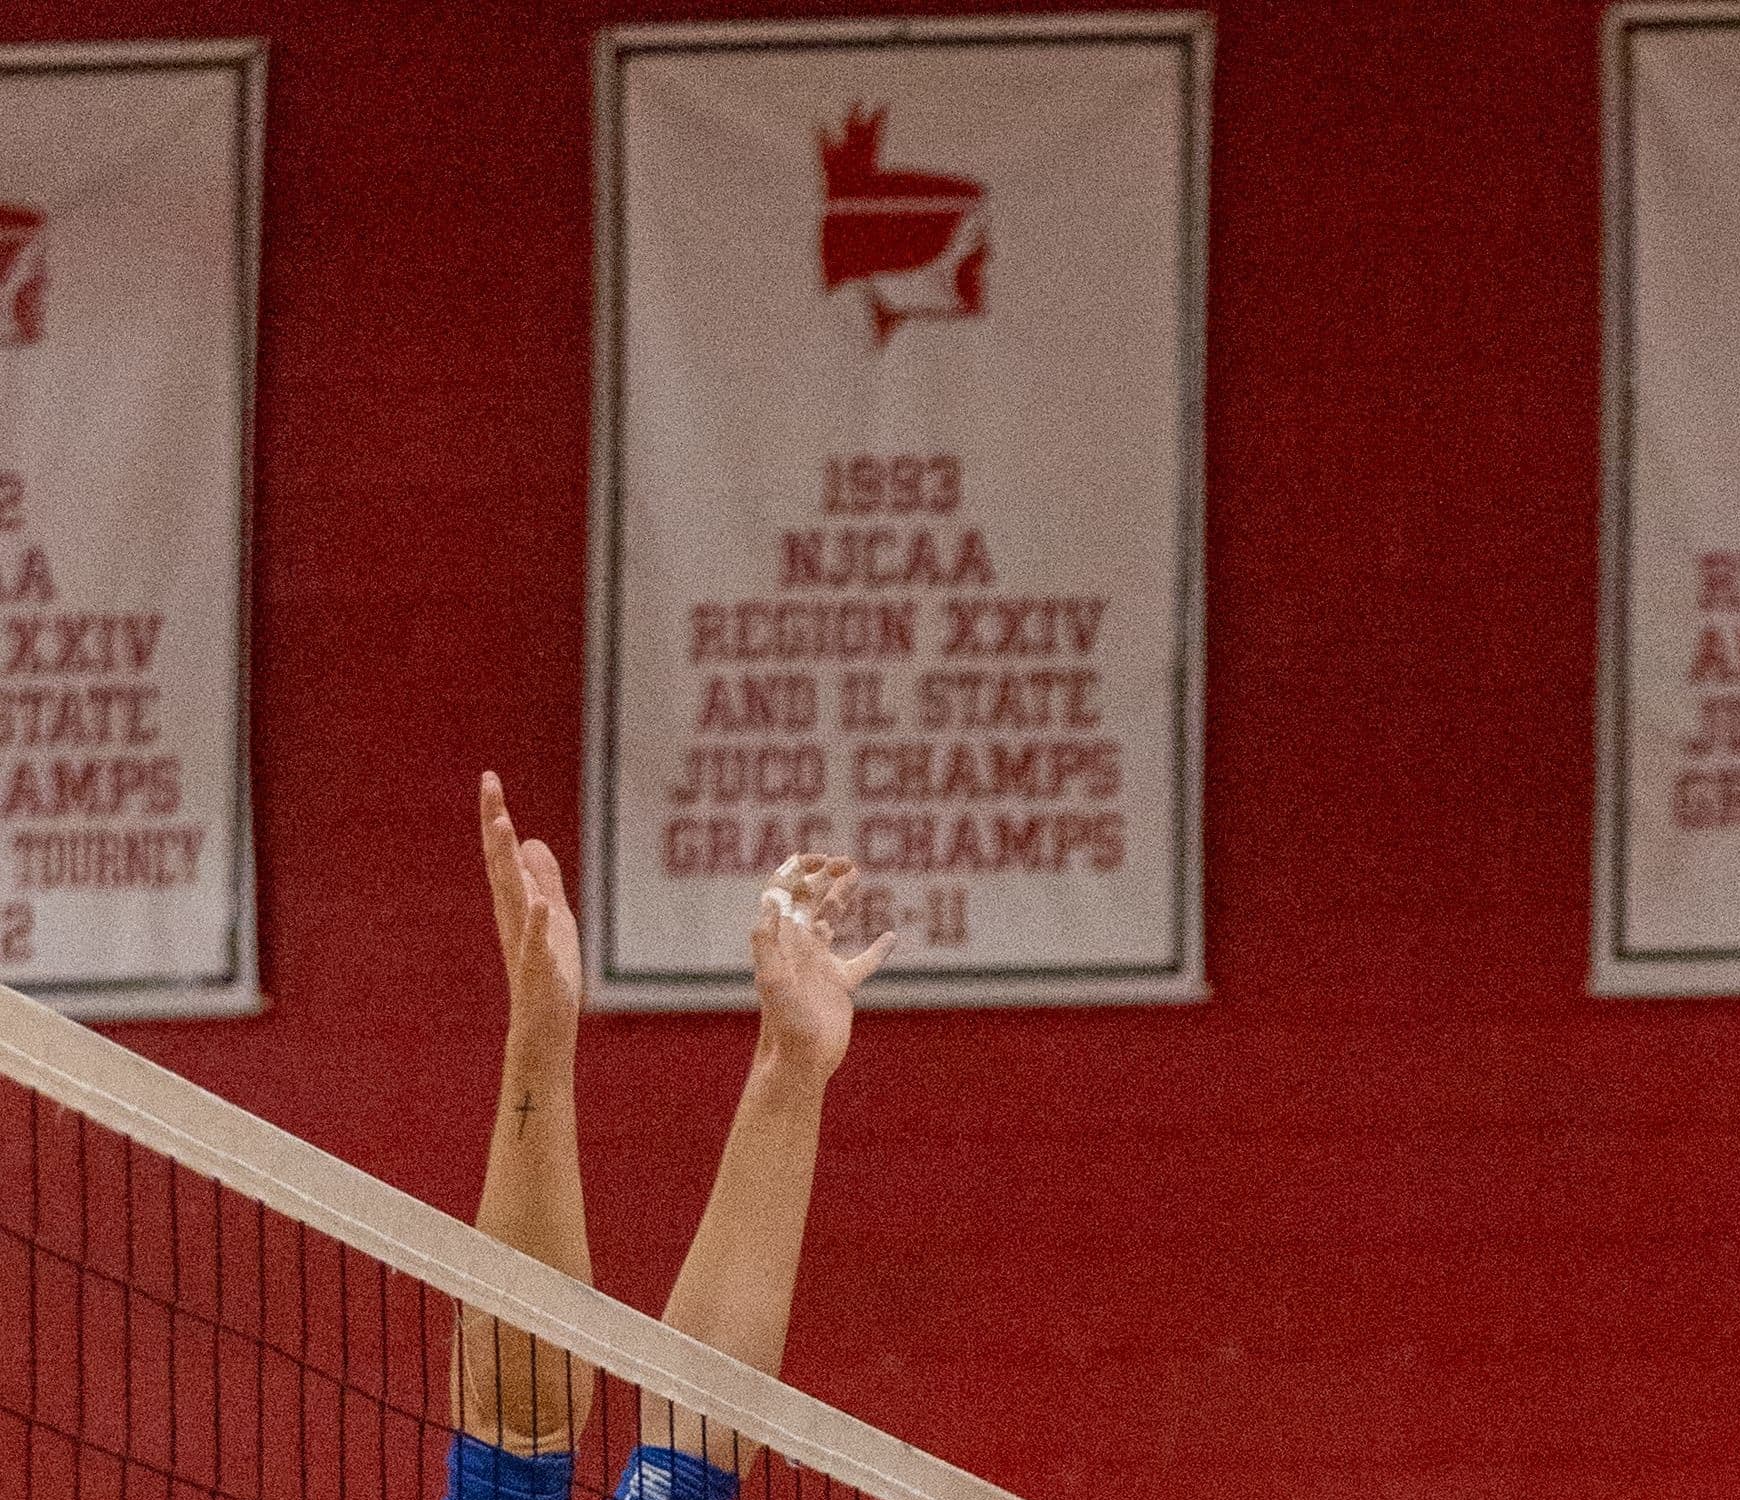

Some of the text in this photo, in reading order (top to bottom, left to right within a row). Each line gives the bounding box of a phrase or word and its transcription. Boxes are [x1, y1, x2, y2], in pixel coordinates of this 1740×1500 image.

[822, 453, 963, 516] 1993
[779, 527, 996, 589] NJCAA
[690, 595, 1110, 663] REGION XXIV
[697, 669, 818, 734] AND
[916, 668, 1104, 732] STATE
[666, 740, 1124, 806] JUCO CHAMPS
[11, 826, 206, 890] TOURNEY
[856, 810, 1128, 874] CHAMPS
